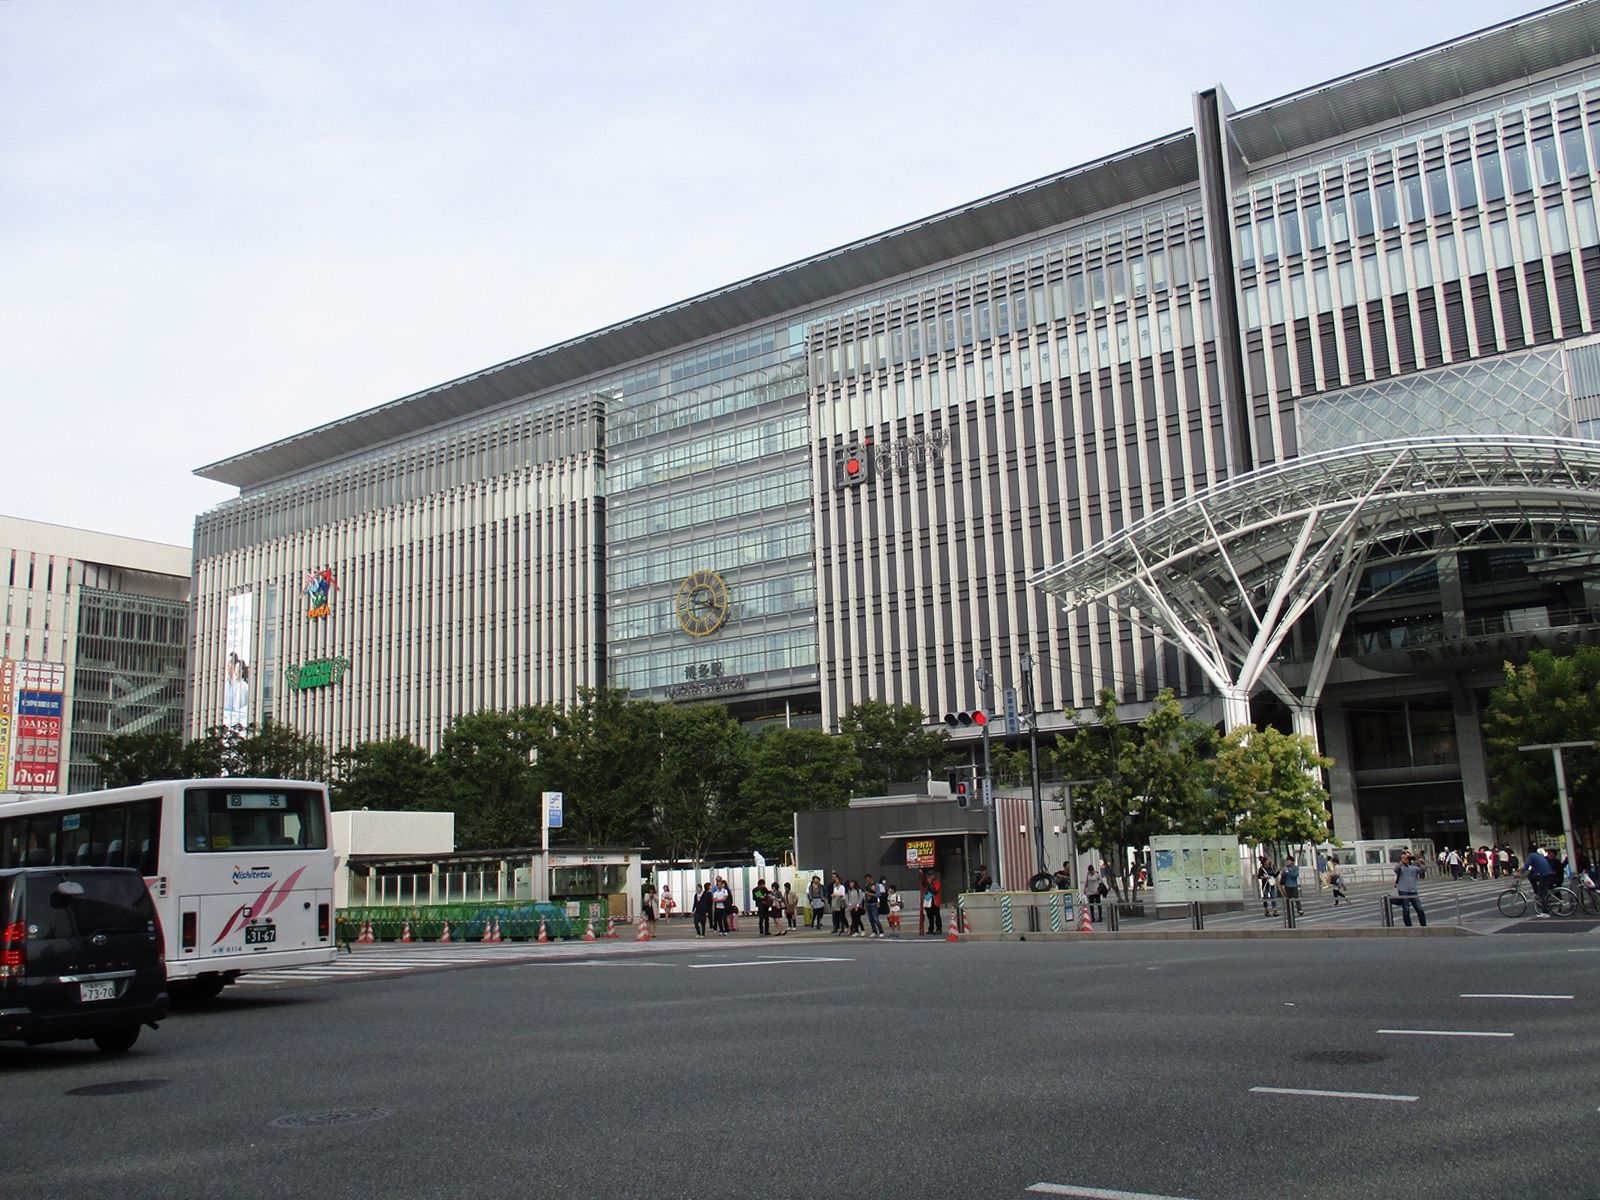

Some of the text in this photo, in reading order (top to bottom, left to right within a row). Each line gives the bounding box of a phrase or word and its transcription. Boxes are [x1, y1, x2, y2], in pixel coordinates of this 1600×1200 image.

[1437, 634, 1544, 659] HAKATA
[23, 674, 59, 685] namco
[21, 720, 58, 729] DAISO
[16, 743, 58, 757] しまむら
[15, 768, 56, 784] Avail
[232, 870, 273, 880] Nishitetsu
